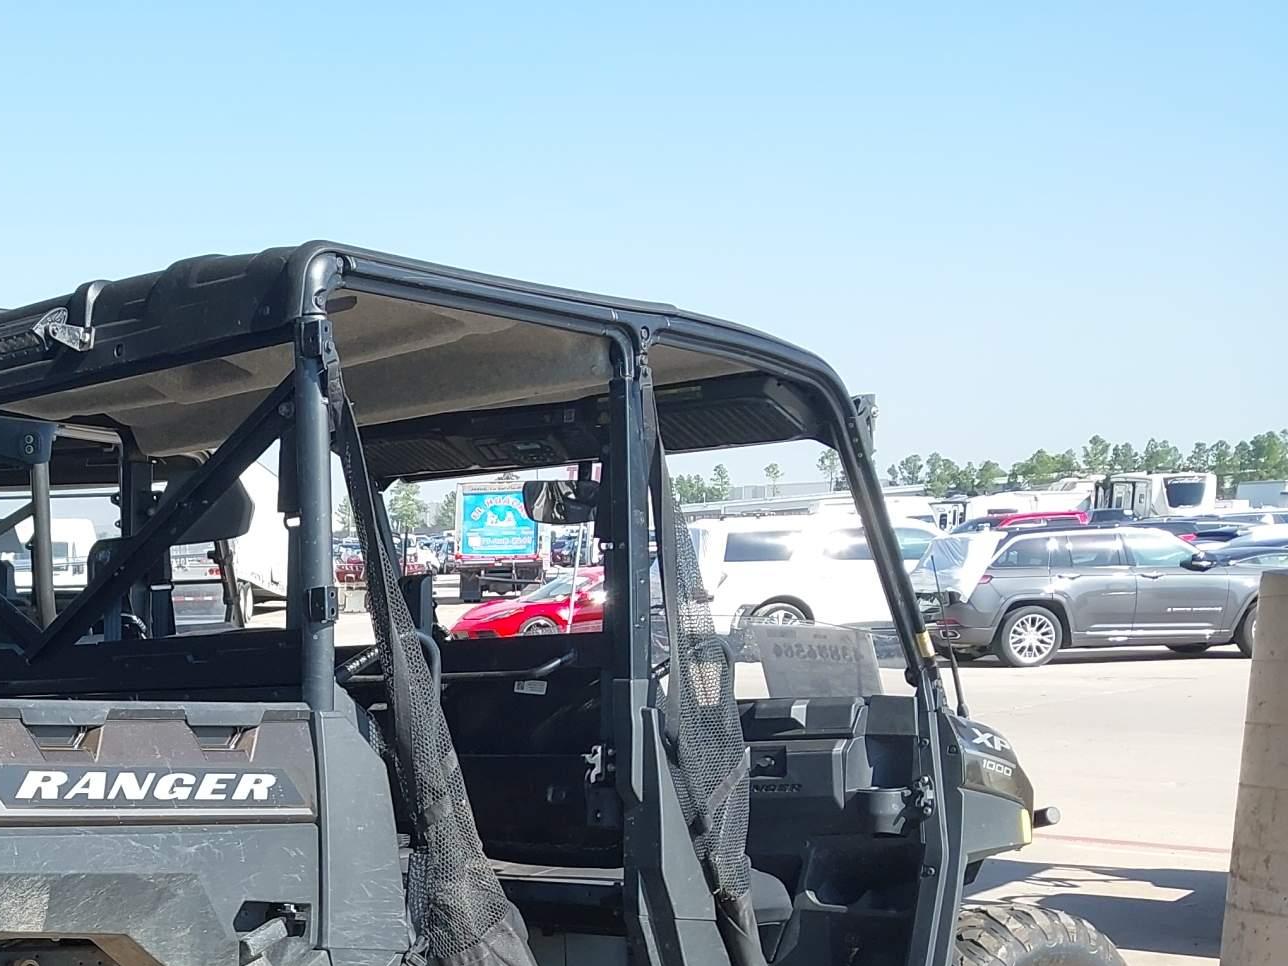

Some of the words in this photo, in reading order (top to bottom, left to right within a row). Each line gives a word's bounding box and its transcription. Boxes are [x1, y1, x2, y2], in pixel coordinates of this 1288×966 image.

[971, 727, 1011, 751] XP
[982, 759, 1012, 777] 1000
[15, 770, 277, 801] RANGER
